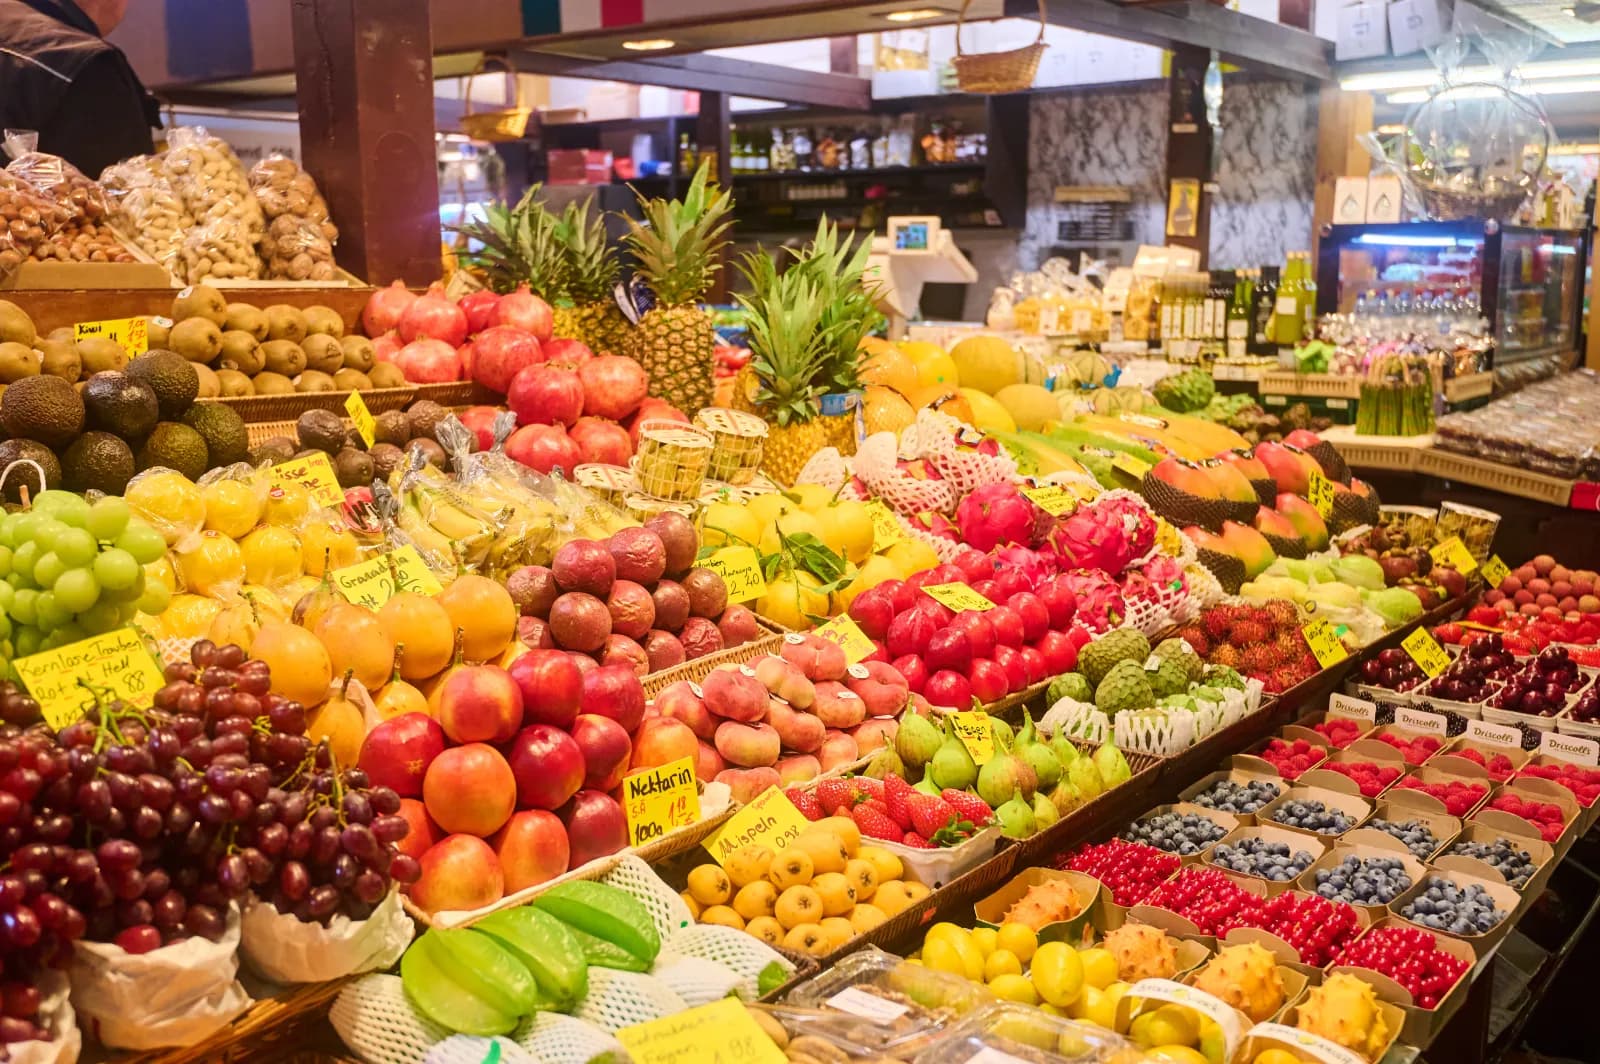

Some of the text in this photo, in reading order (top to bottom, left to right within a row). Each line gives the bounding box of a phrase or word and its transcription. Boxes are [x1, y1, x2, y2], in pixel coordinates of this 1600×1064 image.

[79, 325, 102, 335] Kiwi
[730, 573, 760, 596] 2,40
[629, 767, 692, 799] Nektarin
[718, 816, 778, 859] Mispeln
